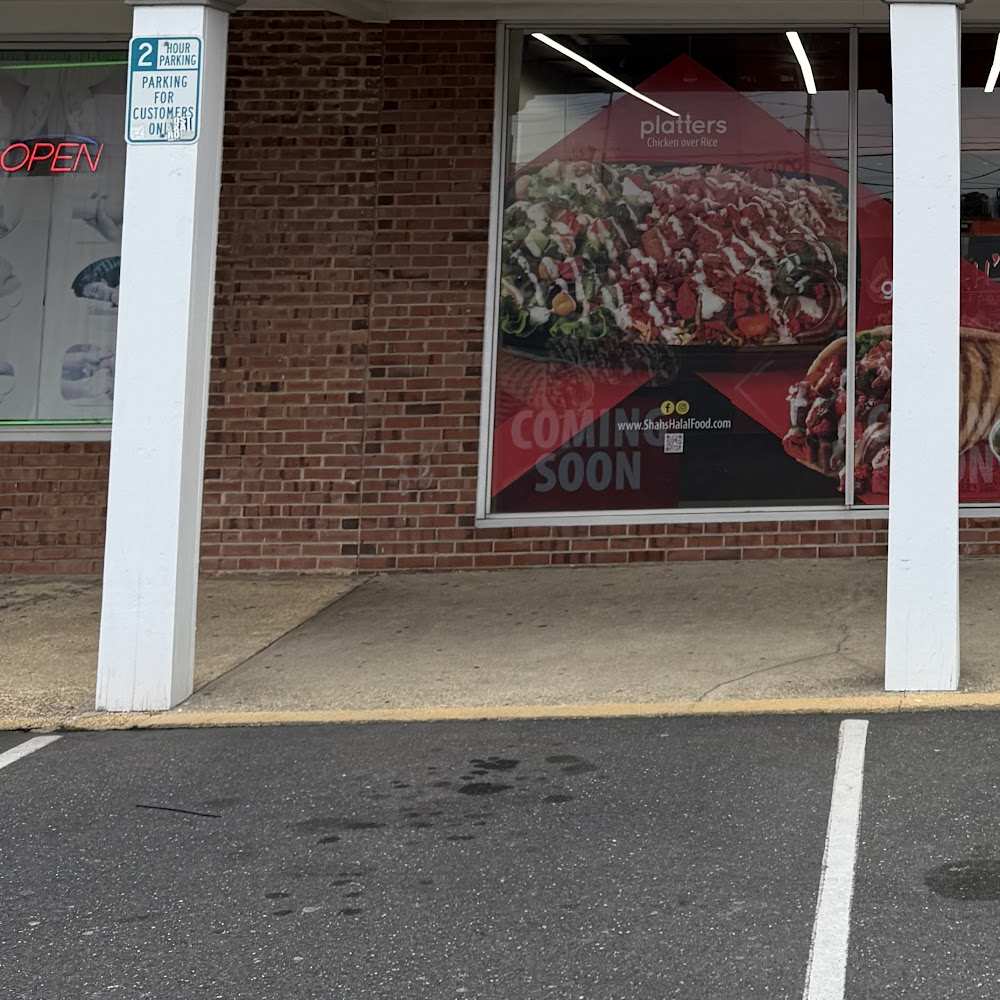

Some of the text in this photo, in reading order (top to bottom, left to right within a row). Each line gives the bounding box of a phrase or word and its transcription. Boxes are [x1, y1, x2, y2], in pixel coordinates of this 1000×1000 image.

[137, 42, 191, 67] 2 HOUR
[159, 54, 197, 67] PARKING
[142, 75, 188, 89] PARKING
[154, 91, 174, 104] FOR
[133, 106, 194, 120] CUSTOMERS
[640, 114, 728, 139] platters
[647, 137, 718, 148] Chicken over Rice
[0, 143, 104, 172] OPEN
[510, 406, 668, 450] COMING
[617, 418, 732, 431] www.ShahsHalalFood.com
[534, 450, 642, 492] SOON
